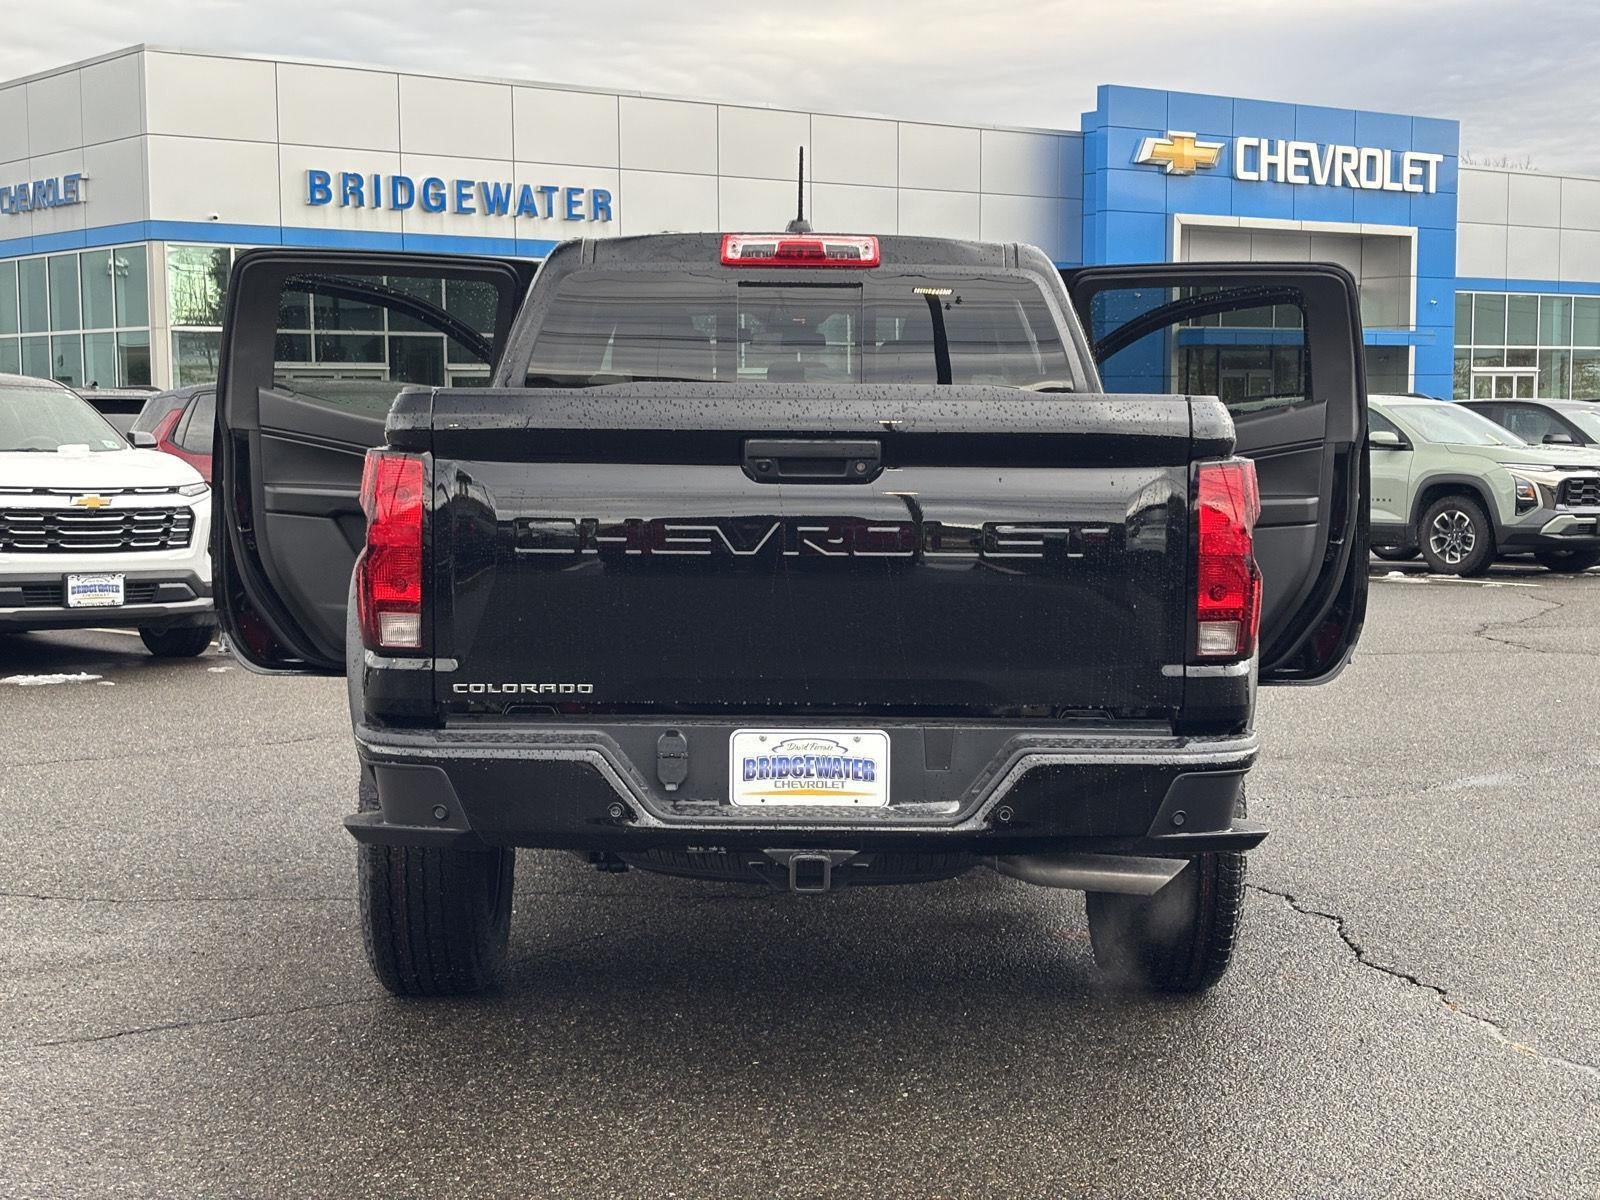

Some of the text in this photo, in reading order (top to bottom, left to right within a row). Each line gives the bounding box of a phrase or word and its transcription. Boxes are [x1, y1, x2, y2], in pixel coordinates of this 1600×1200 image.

[1236, 136, 1443, 194] CHEVROLET
[0, 173, 81, 214] CHEVROLET
[306, 169, 613, 222] BRIDGEWATER
[513, 516, 1109, 559] CHEVROLET
[452, 683, 594, 694] COLORADO
[743, 755, 877, 781] BRIDGEWATER
[774, 780, 846, 789] CHEVROLET
